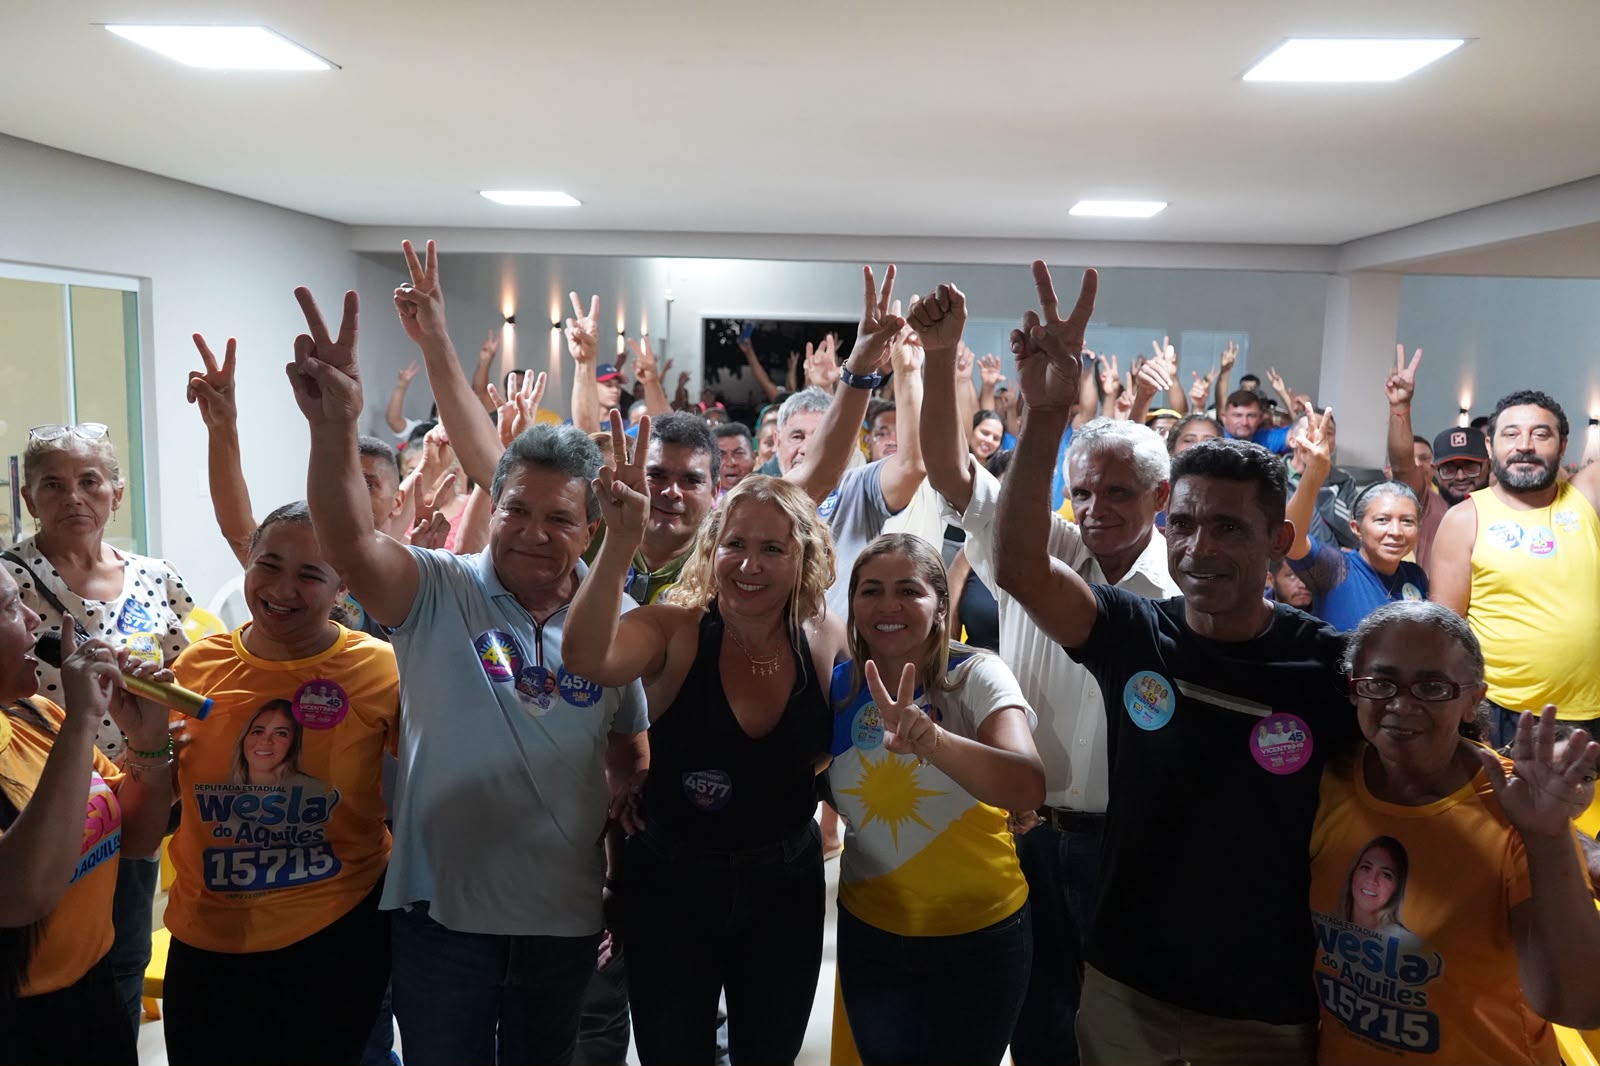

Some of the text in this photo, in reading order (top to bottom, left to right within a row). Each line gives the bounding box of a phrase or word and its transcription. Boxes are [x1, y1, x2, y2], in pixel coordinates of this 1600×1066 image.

[326, 699, 340, 707] 45
[1288, 732, 1303, 742] 45
[685, 775, 730, 798] 4577
[213, 822, 324, 847] do Aquiles
[211, 847, 333, 886] 15715
[1344, 922, 1383, 941] ESTADUAL
[1322, 955, 1427, 1006] do Aquiles
[1322, 978, 1429, 1047] 15715
